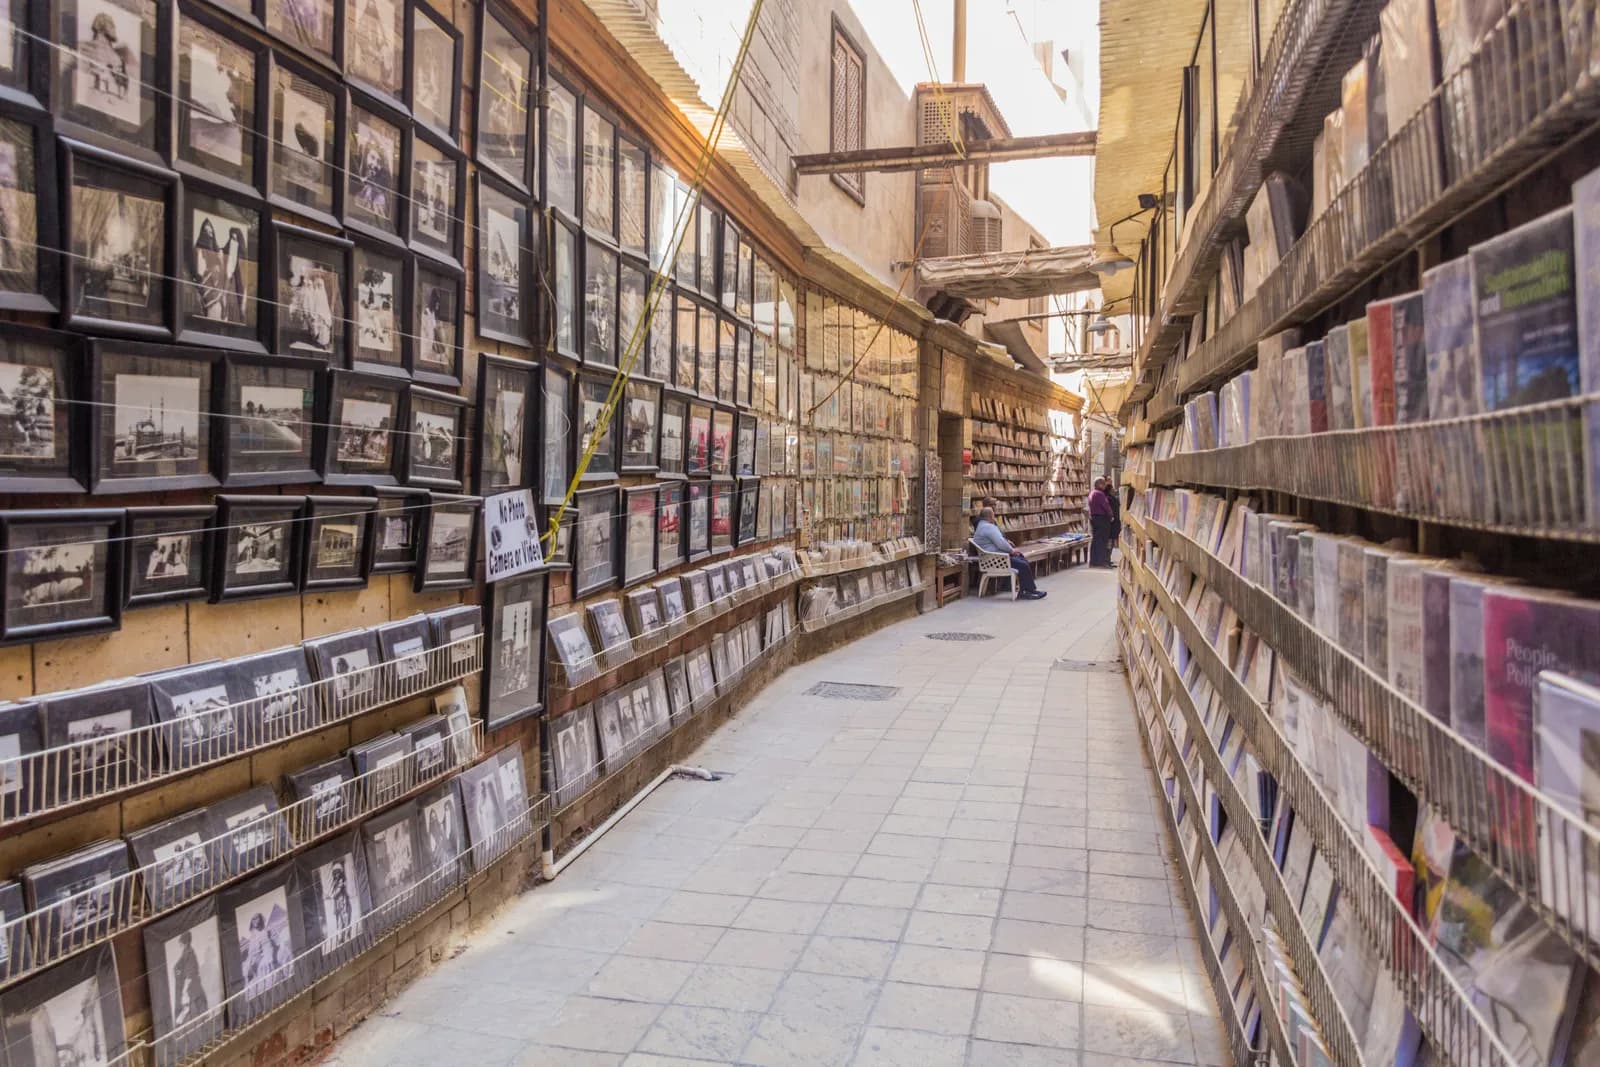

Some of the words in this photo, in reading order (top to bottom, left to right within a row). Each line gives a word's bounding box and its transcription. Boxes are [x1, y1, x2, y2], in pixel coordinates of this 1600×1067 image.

[499, 500, 507, 524] No
[508, 497, 525, 520] Photo
[489, 550, 514, 575] Camera
[514, 548, 522, 567] or
[521, 540, 541, 564] Video
